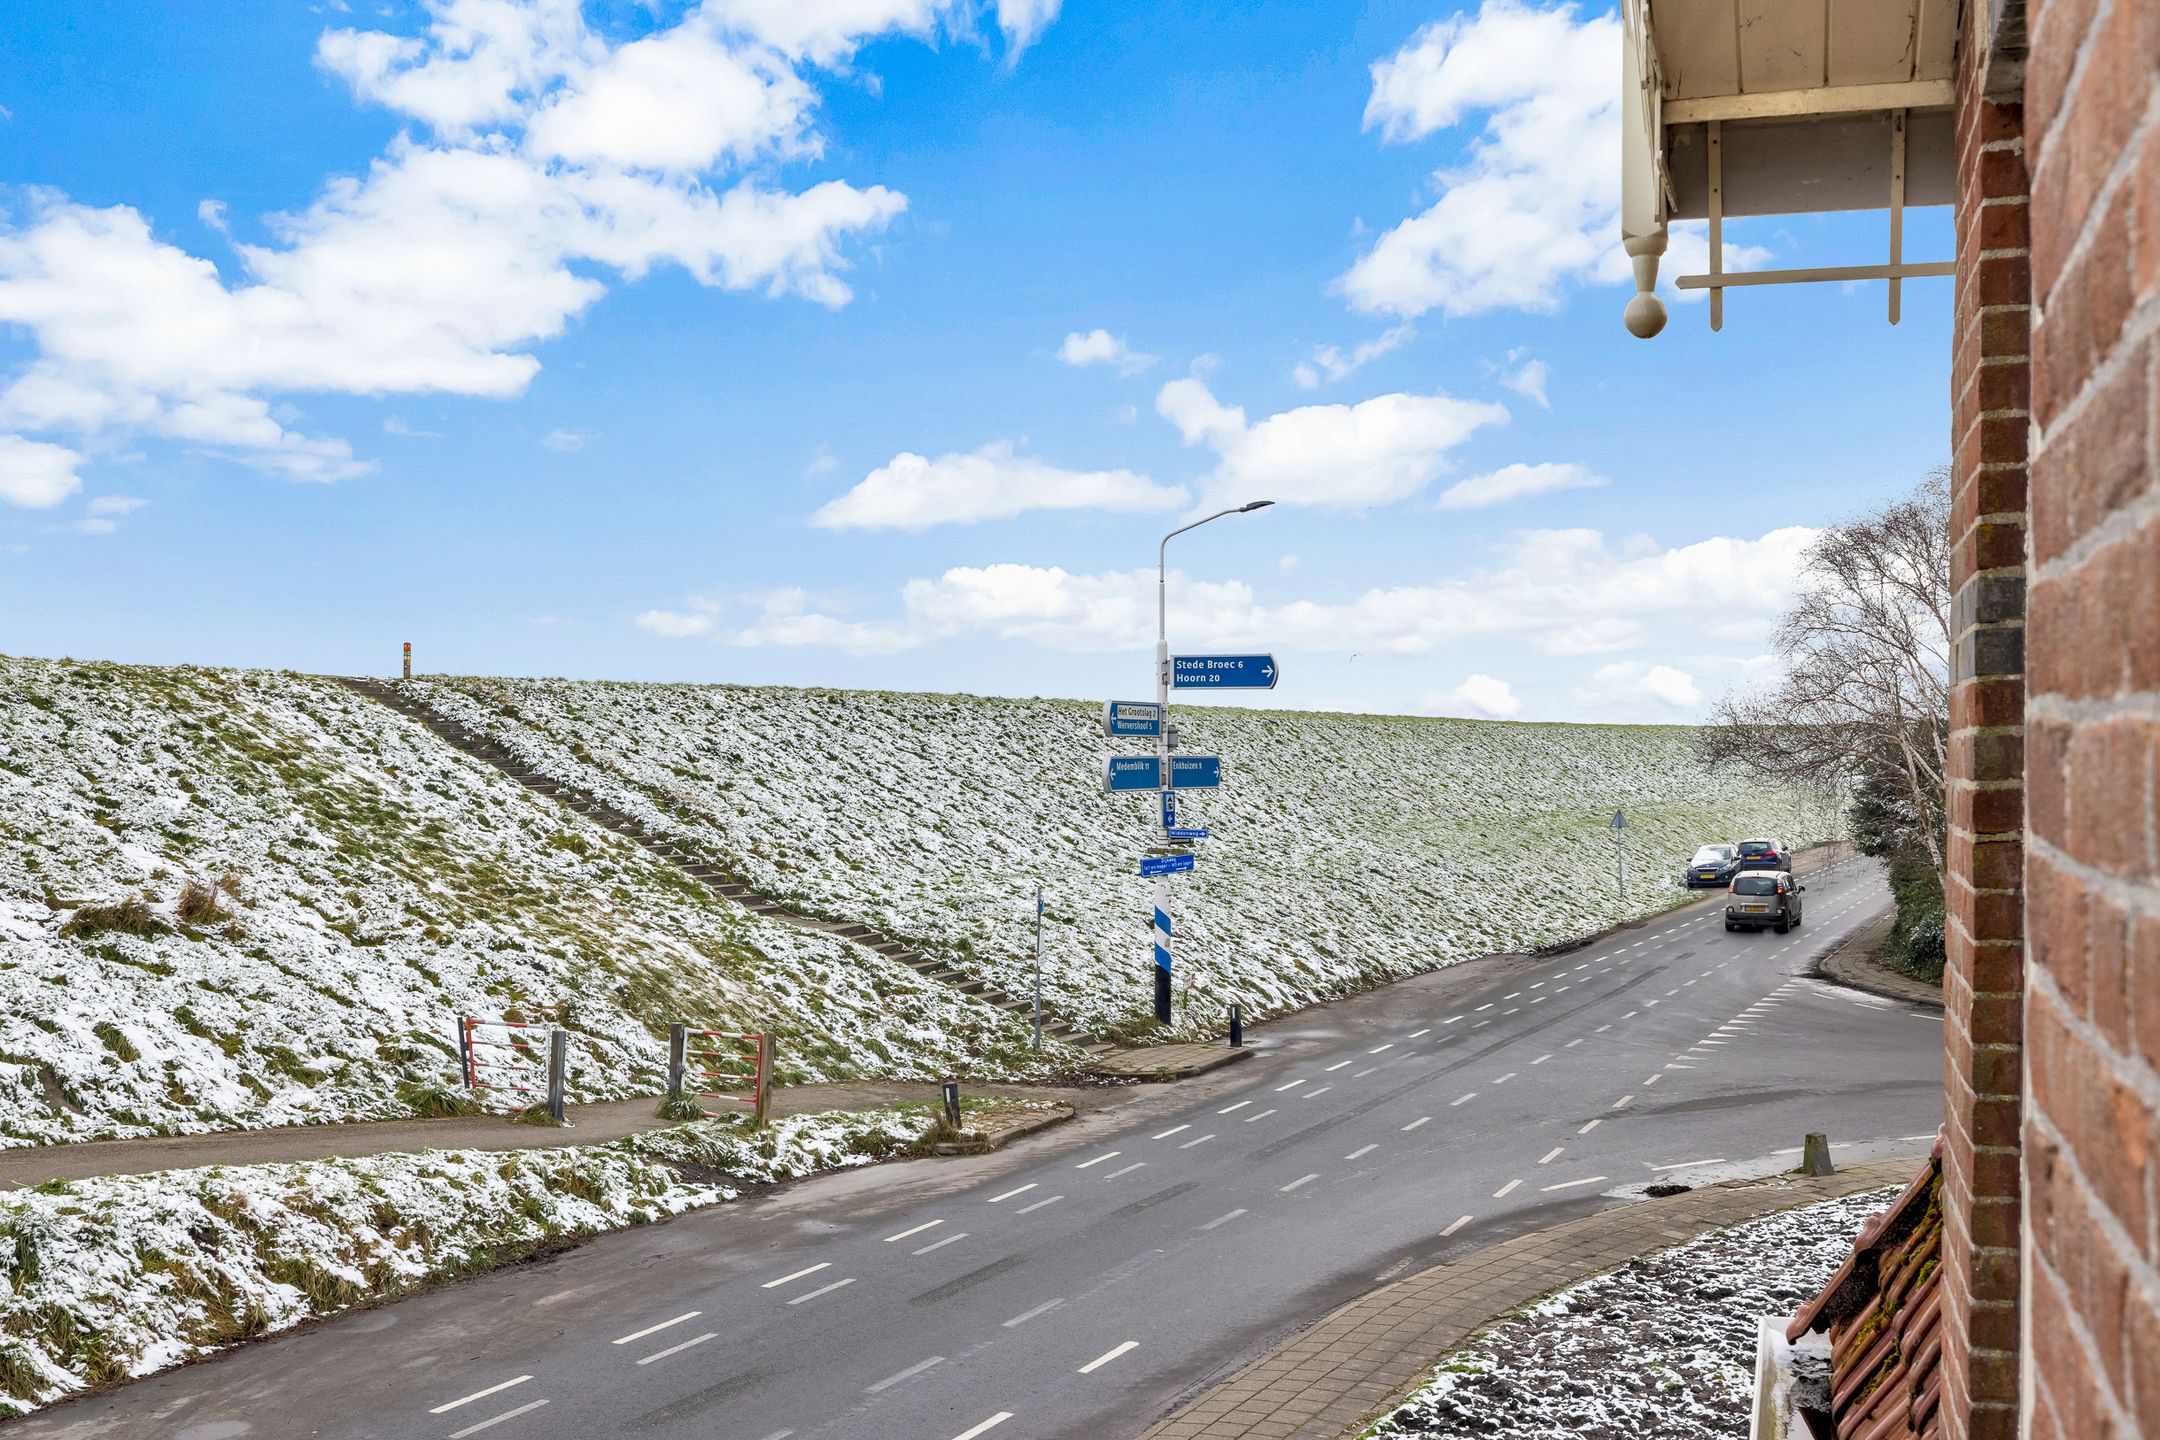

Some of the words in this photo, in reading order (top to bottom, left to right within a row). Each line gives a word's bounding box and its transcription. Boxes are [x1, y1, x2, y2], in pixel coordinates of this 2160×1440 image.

[1176, 660, 1204, 669] Stede
[1207, 660, 1235, 669] Broec
[1238, 660, 1244, 668] 6
[1176, 673, 1206, 682] Hoorn
[1208, 674, 1220, 682] 20
[1118, 706, 1128, 716] Het
[1128, 707, 1152, 719] Grootslag
[1116, 761, 1144, 771] Medemblik
[1144, 762, 1150, 770] 11
[1172, 761, 1198, 770] Enkhuizen
[1198, 762, 1203, 770] 9
